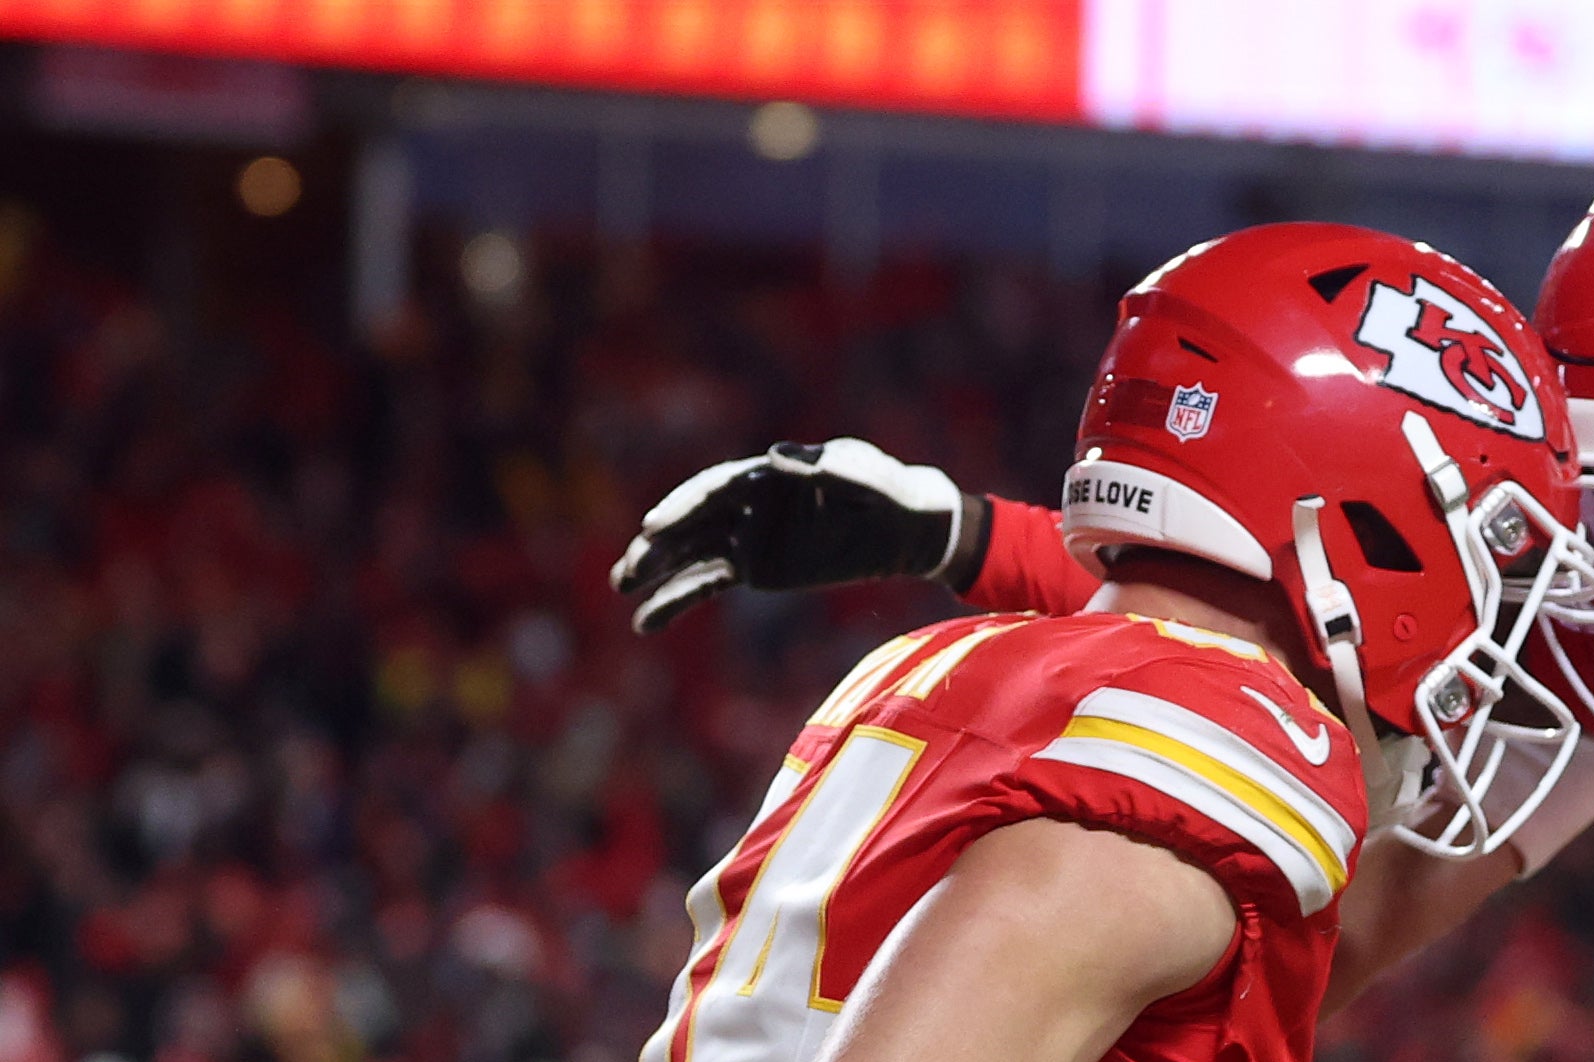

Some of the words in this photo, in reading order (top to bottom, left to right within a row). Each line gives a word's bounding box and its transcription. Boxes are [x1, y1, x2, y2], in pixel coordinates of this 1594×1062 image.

[1405, 297, 1528, 426] KC
[1173, 407, 1204, 432] NFL
[1095, 479, 1154, 514] LOVE
